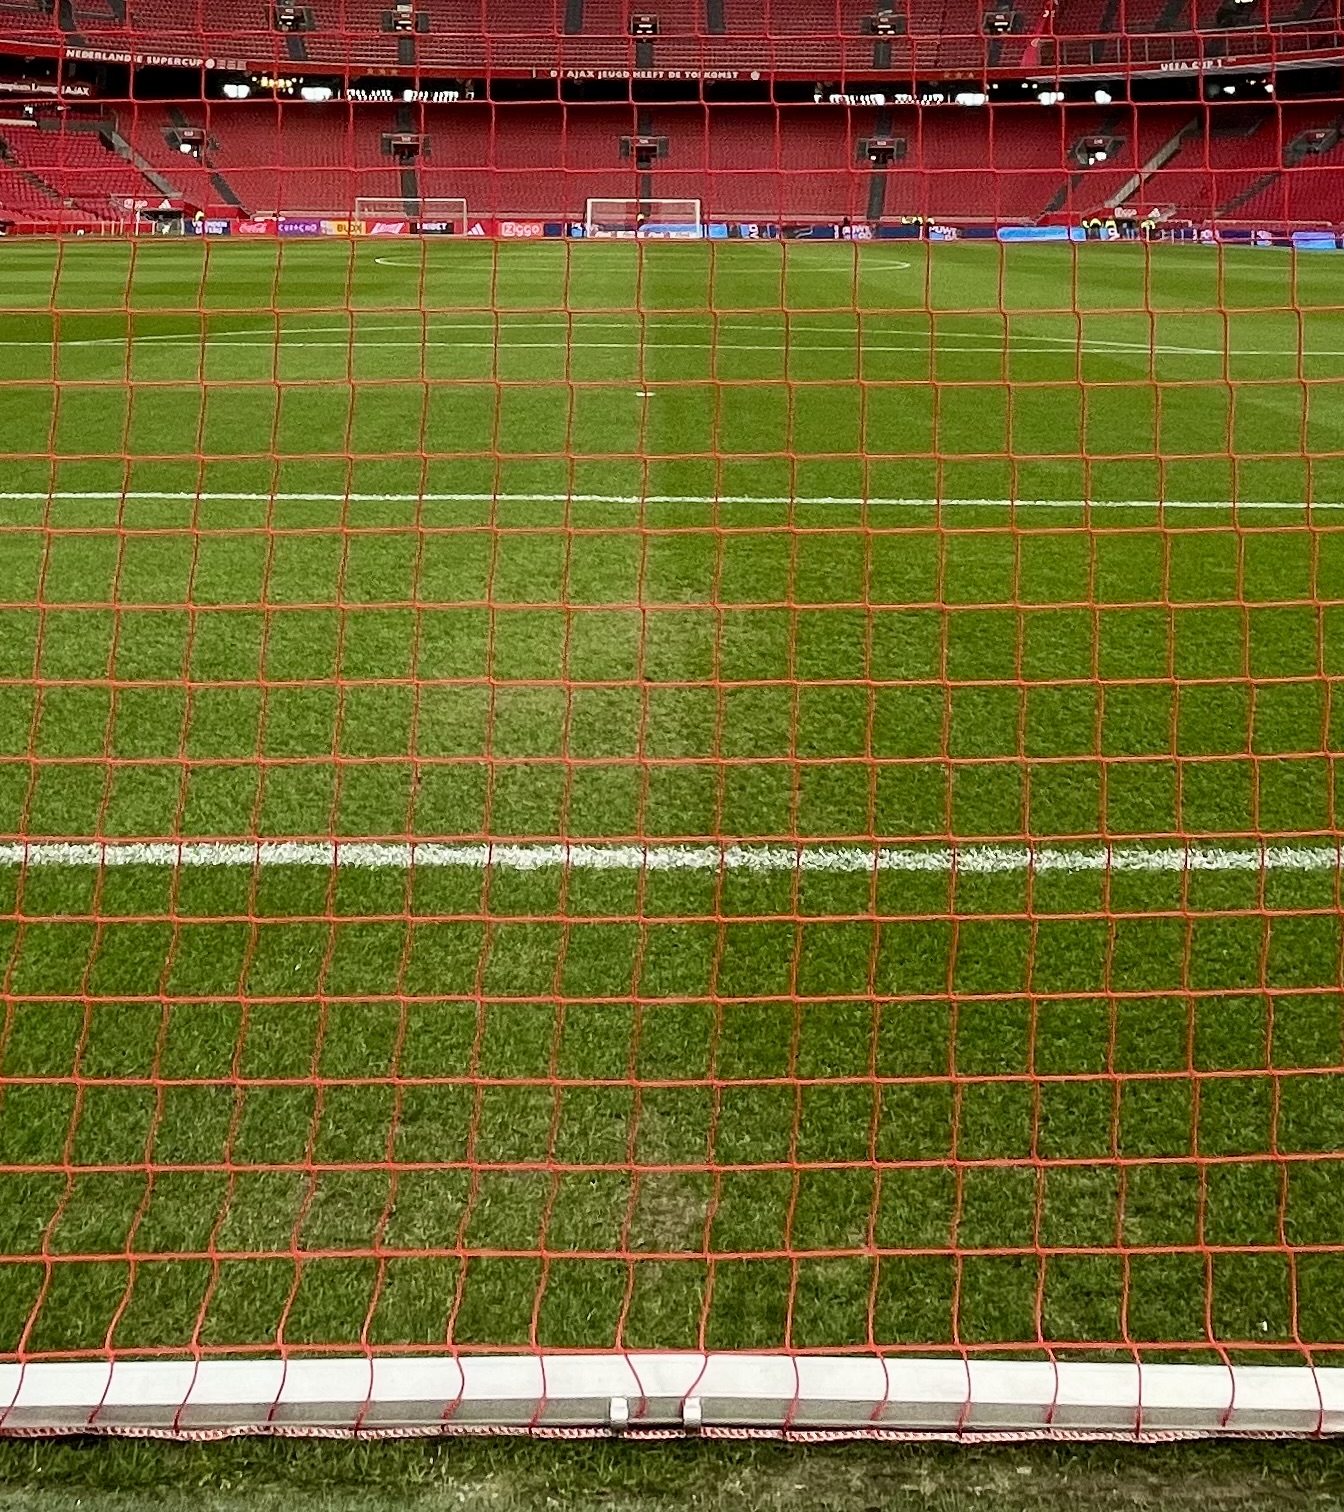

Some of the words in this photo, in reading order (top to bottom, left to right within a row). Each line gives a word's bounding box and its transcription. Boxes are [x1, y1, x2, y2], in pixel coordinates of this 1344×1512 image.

[566, 70, 595, 79] AJAX
[597, 70, 630, 80] JEUGD
[632, 70, 665, 79] HEEFT
[668, 70, 681, 79] DE
[65, 85, 90, 97] AJAX
[502, 222, 540, 237] Ziggo
